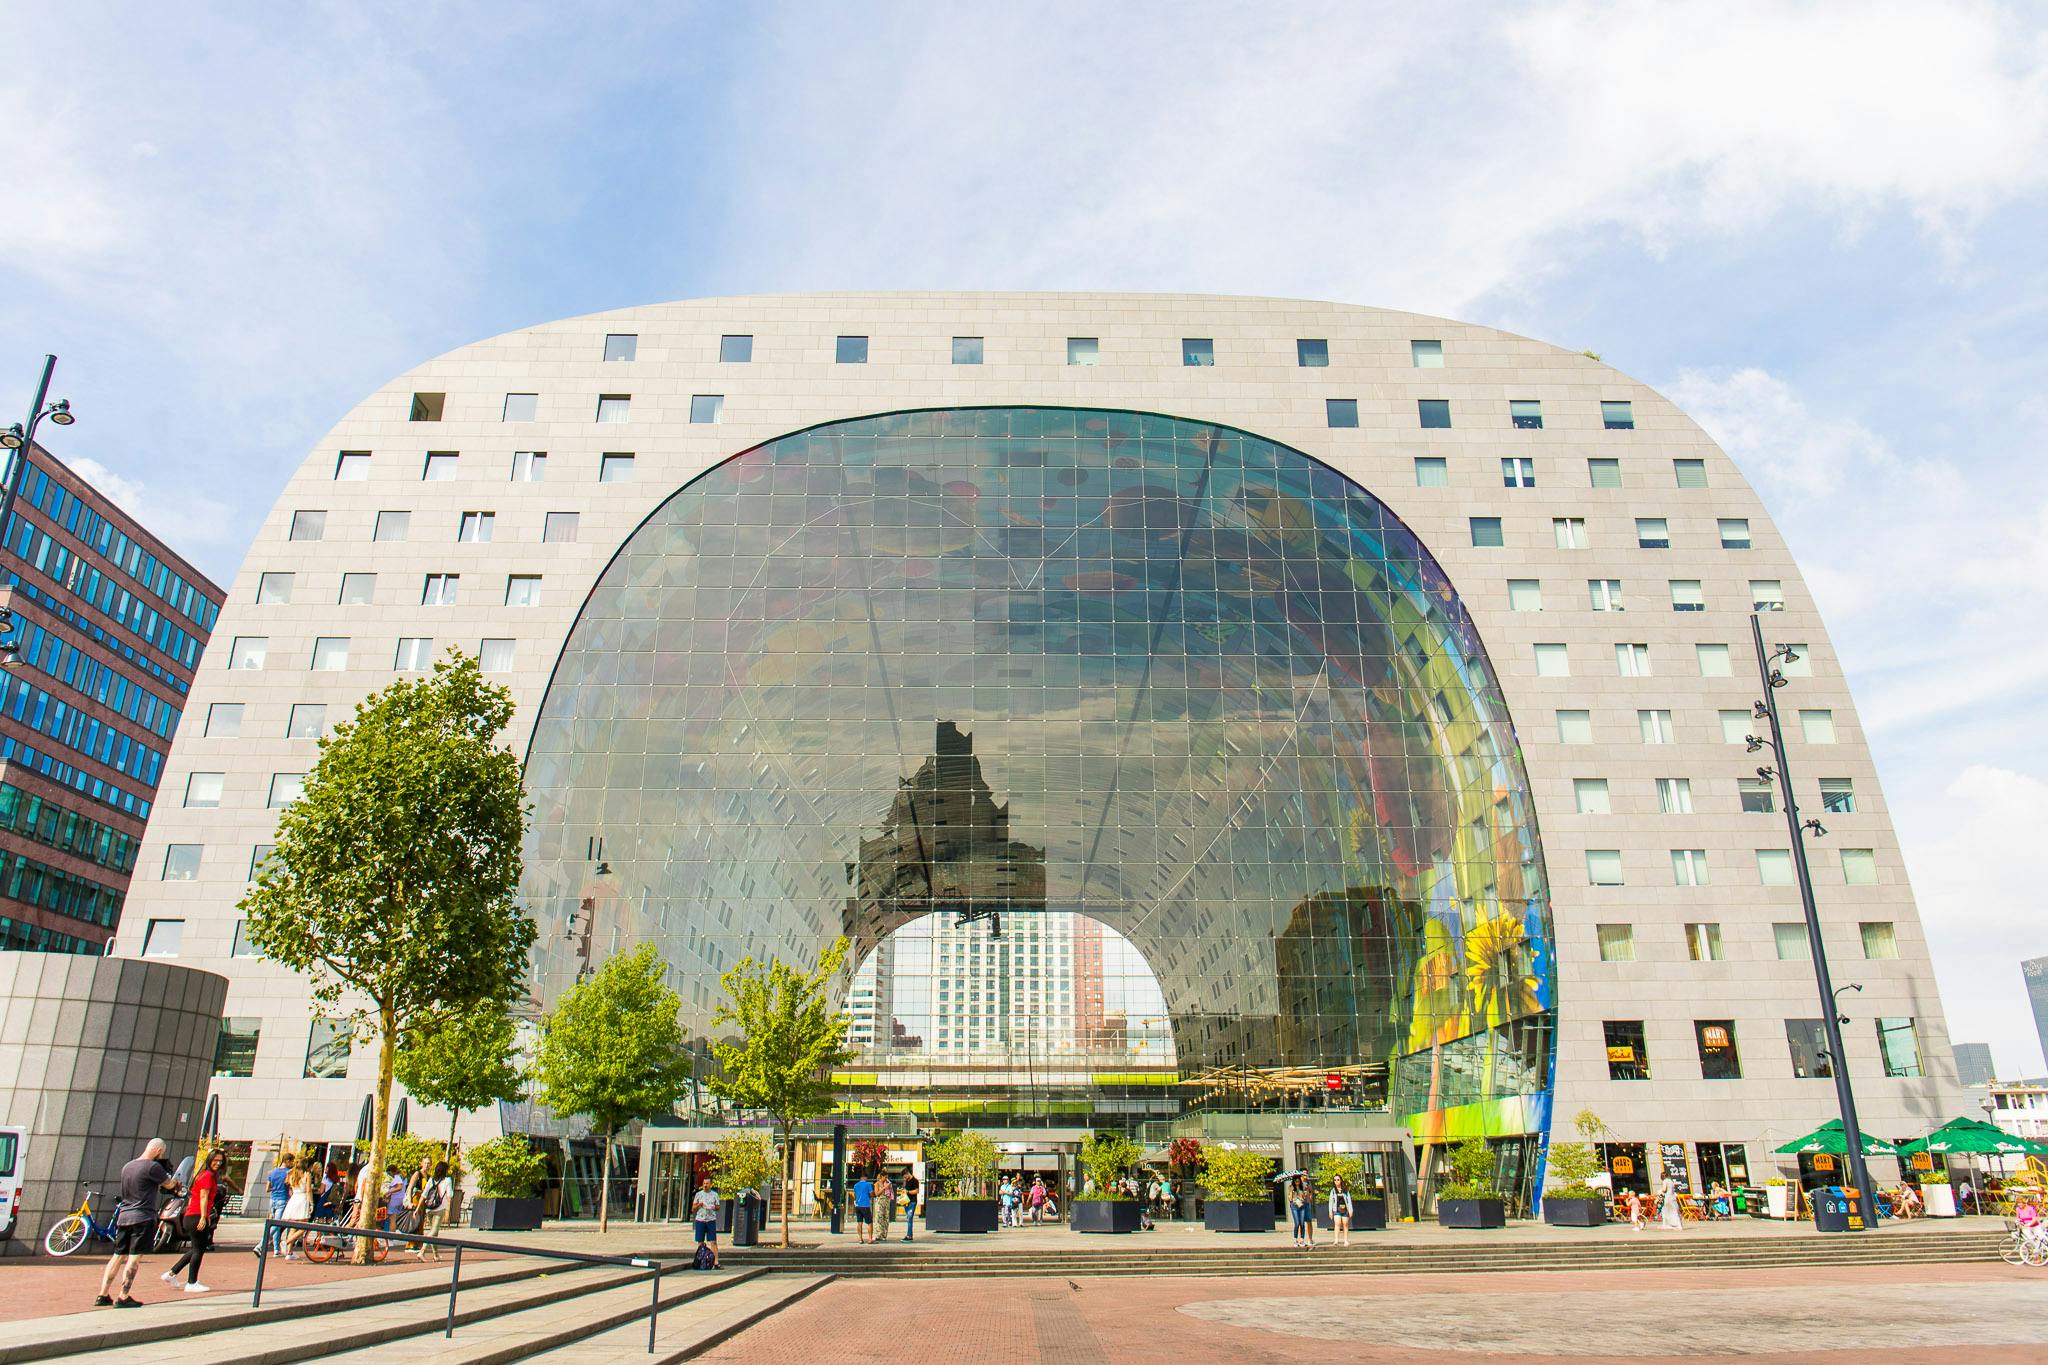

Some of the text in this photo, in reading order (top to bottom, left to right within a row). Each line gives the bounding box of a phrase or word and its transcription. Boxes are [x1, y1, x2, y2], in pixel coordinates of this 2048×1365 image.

[1705, 1027, 1726, 1039] MART
[1615, 1158, 1630, 1167] MART
[1815, 1155, 1831, 1164] MART
